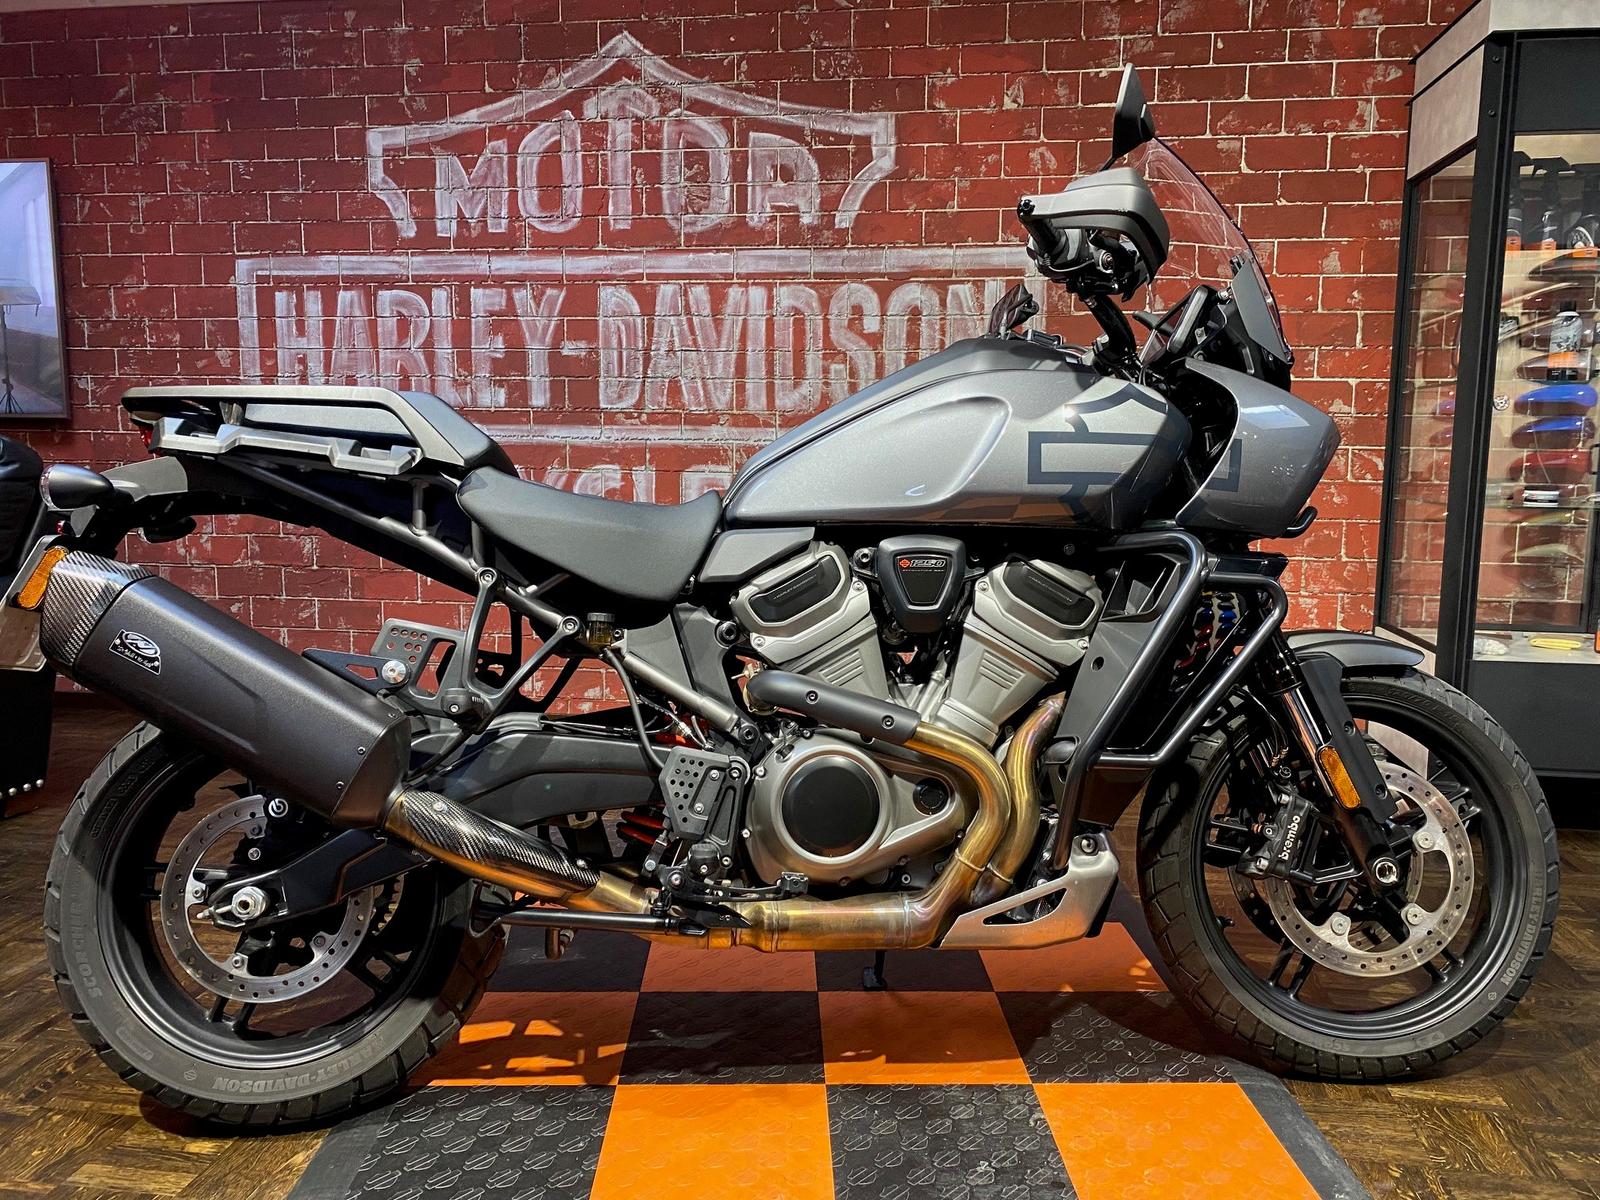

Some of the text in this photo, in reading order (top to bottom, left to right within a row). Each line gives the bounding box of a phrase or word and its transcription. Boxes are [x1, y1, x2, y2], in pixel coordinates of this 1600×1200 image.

[434, 78, 823, 237] MOTOR
[1278, 815, 1301, 861] brembo
[211, 1034, 385, 1094] HARLEY-DAVIDSON
